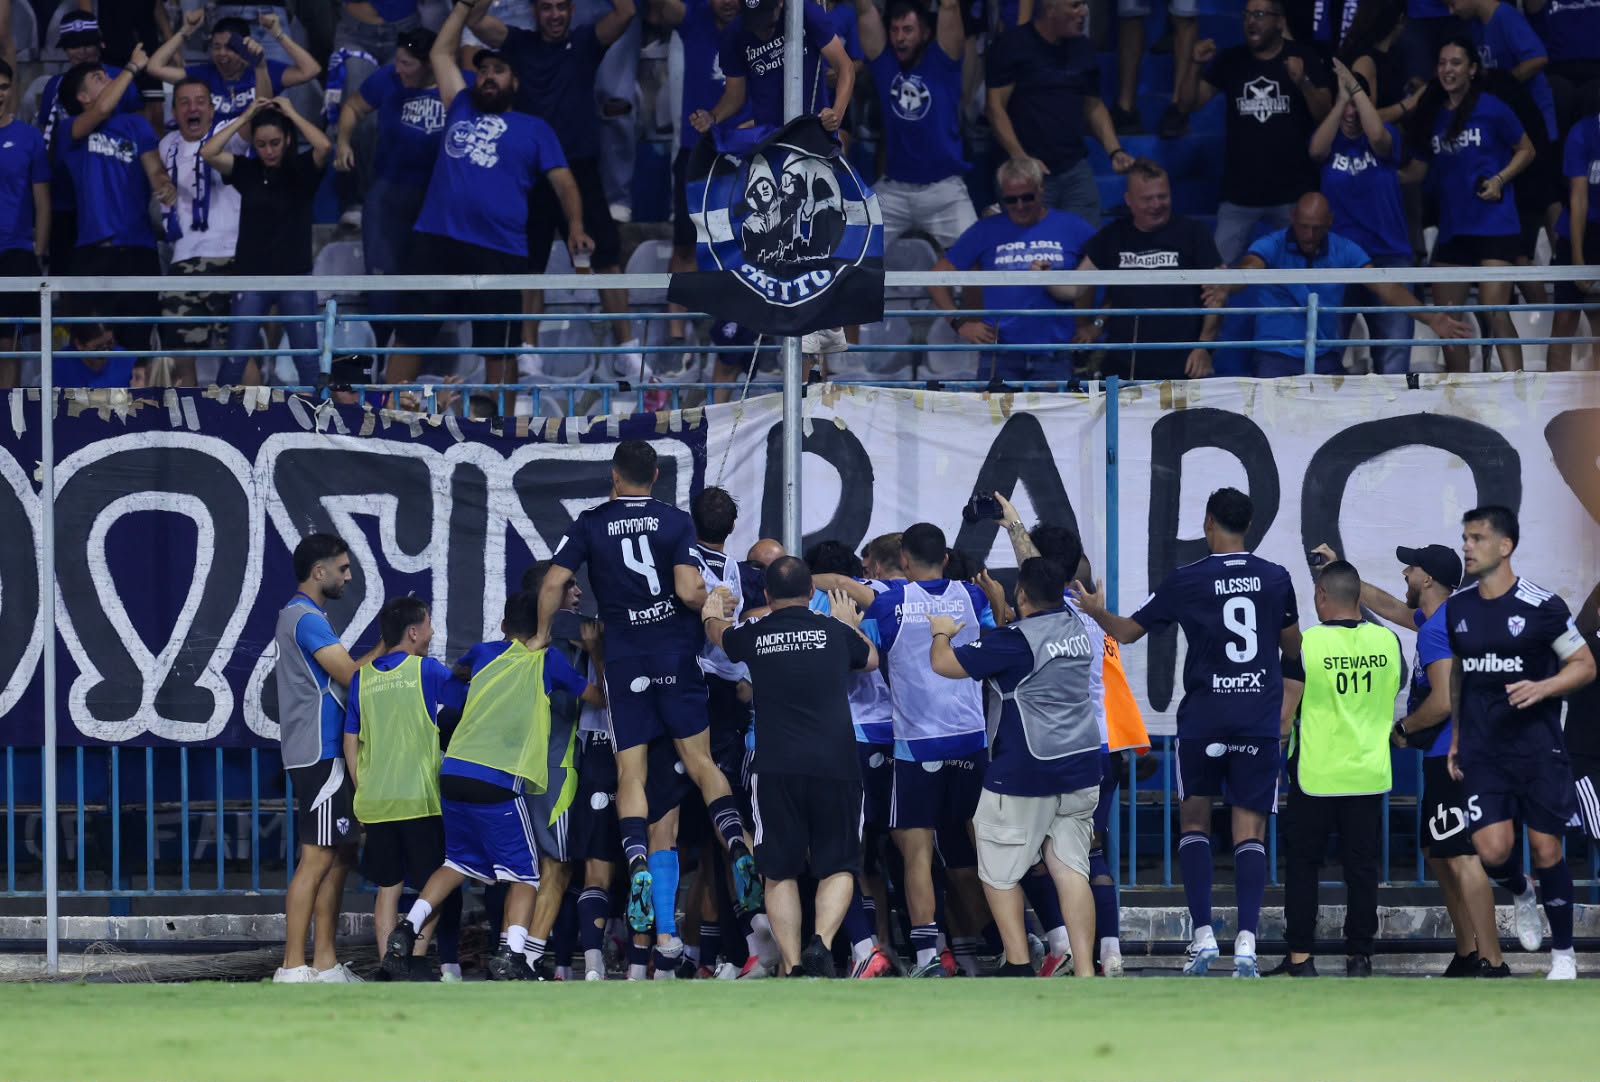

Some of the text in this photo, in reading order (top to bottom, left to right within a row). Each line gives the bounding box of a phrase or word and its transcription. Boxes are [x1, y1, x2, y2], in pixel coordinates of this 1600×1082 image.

[620, 534, 661, 596] 4
[1214, 576, 1261, 596] ALESSIO
[627, 599, 675, 621] IronFX
[894, 599, 965, 617] ANORTHOSIS
[755, 630, 827, 648] ANORTHOSIS
[1222, 596, 1258, 664] 9
[757, 642, 813, 656] FAMAGUSTA FC
[1046, 634, 1091, 659] PHOTO
[1323, 654, 1388, 670] STEWARD
[1213, 672, 1262, 689] IronFX
[1336, 671, 1372, 695] 011
